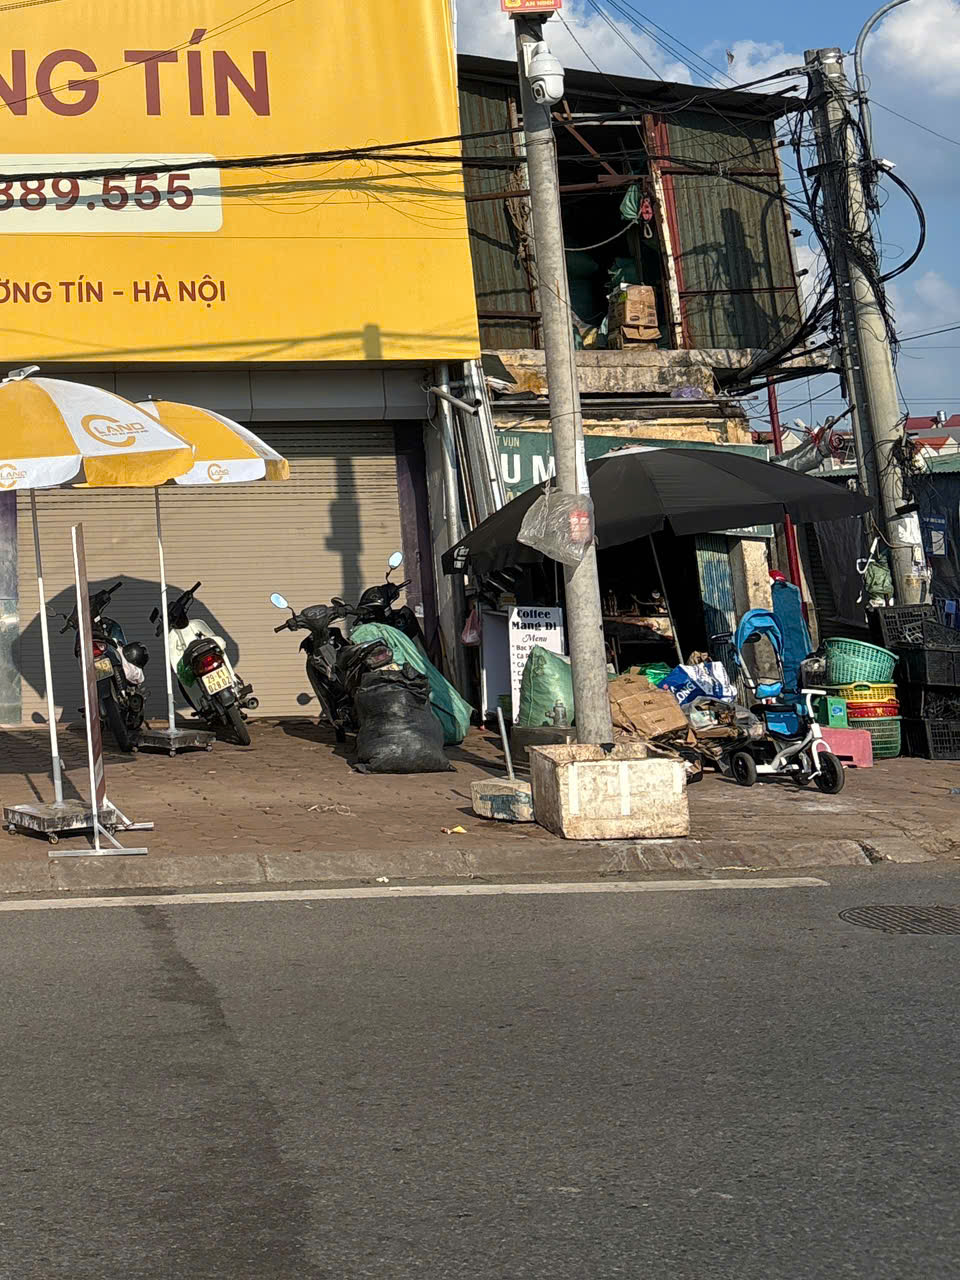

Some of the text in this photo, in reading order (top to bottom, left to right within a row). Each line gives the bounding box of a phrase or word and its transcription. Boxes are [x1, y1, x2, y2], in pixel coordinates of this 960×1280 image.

[123, 28, 271, 117] TÍN
[59, 274, 103, 303] TÍN
[132, 273, 171, 302] HÀ
[178, 273, 226, 308] NỘI
[516, 609, 551, 619] Coffee
[511, 621, 541, 631] Mang
[522, 634, 547, 642] Menu
